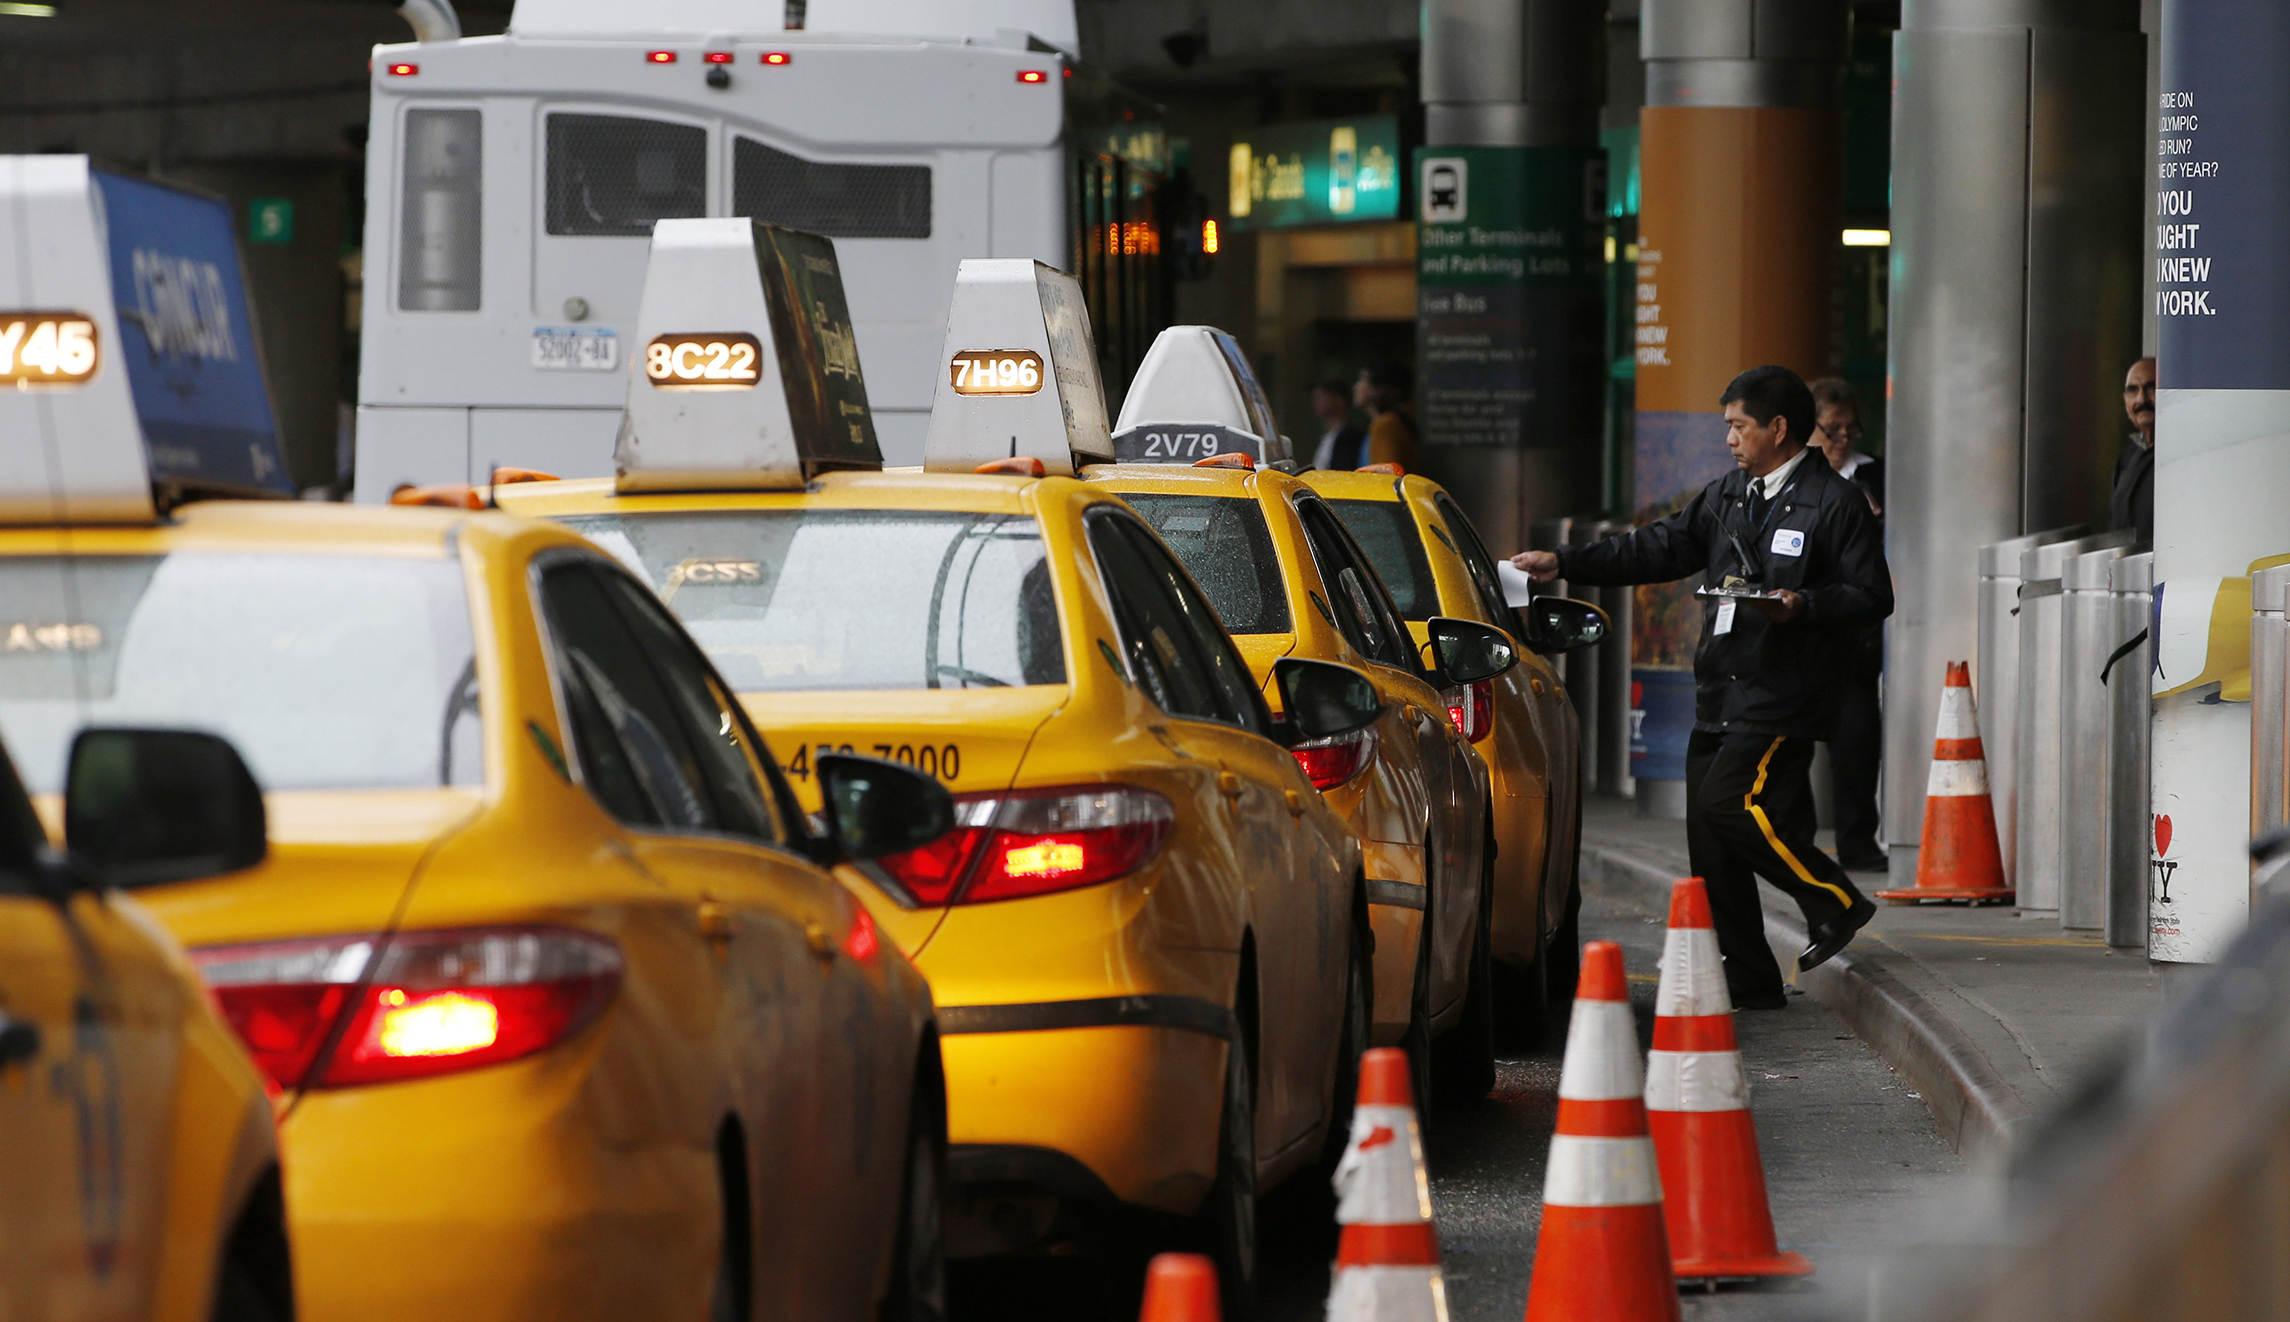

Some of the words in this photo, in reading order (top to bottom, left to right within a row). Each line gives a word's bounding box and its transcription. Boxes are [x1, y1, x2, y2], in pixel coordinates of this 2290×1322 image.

[2177, 92, 2193, 108] ON
[2167, 138, 2192, 155] RUN?
[2166, 162, 2178, 178] OF
[2179, 161, 2219, 178] YEAR?
[2162, 190, 2193, 216] YOU
[1469, 227, 1563, 247] Terminals
[1451, 254, 1524, 279] Parking
[1530, 256, 1570, 274] Lots
[2161, 257, 2212, 282] KNEW
[1453, 292, 1488, 313] Bus
[2162, 290, 2216, 316] YORK.
[0, 321, 96, 375] Y45
[646, 341, 757, 379] 8C22
[952, 358, 1039, 388] 7H96
[1144, 432, 1218, 457] 2V79
